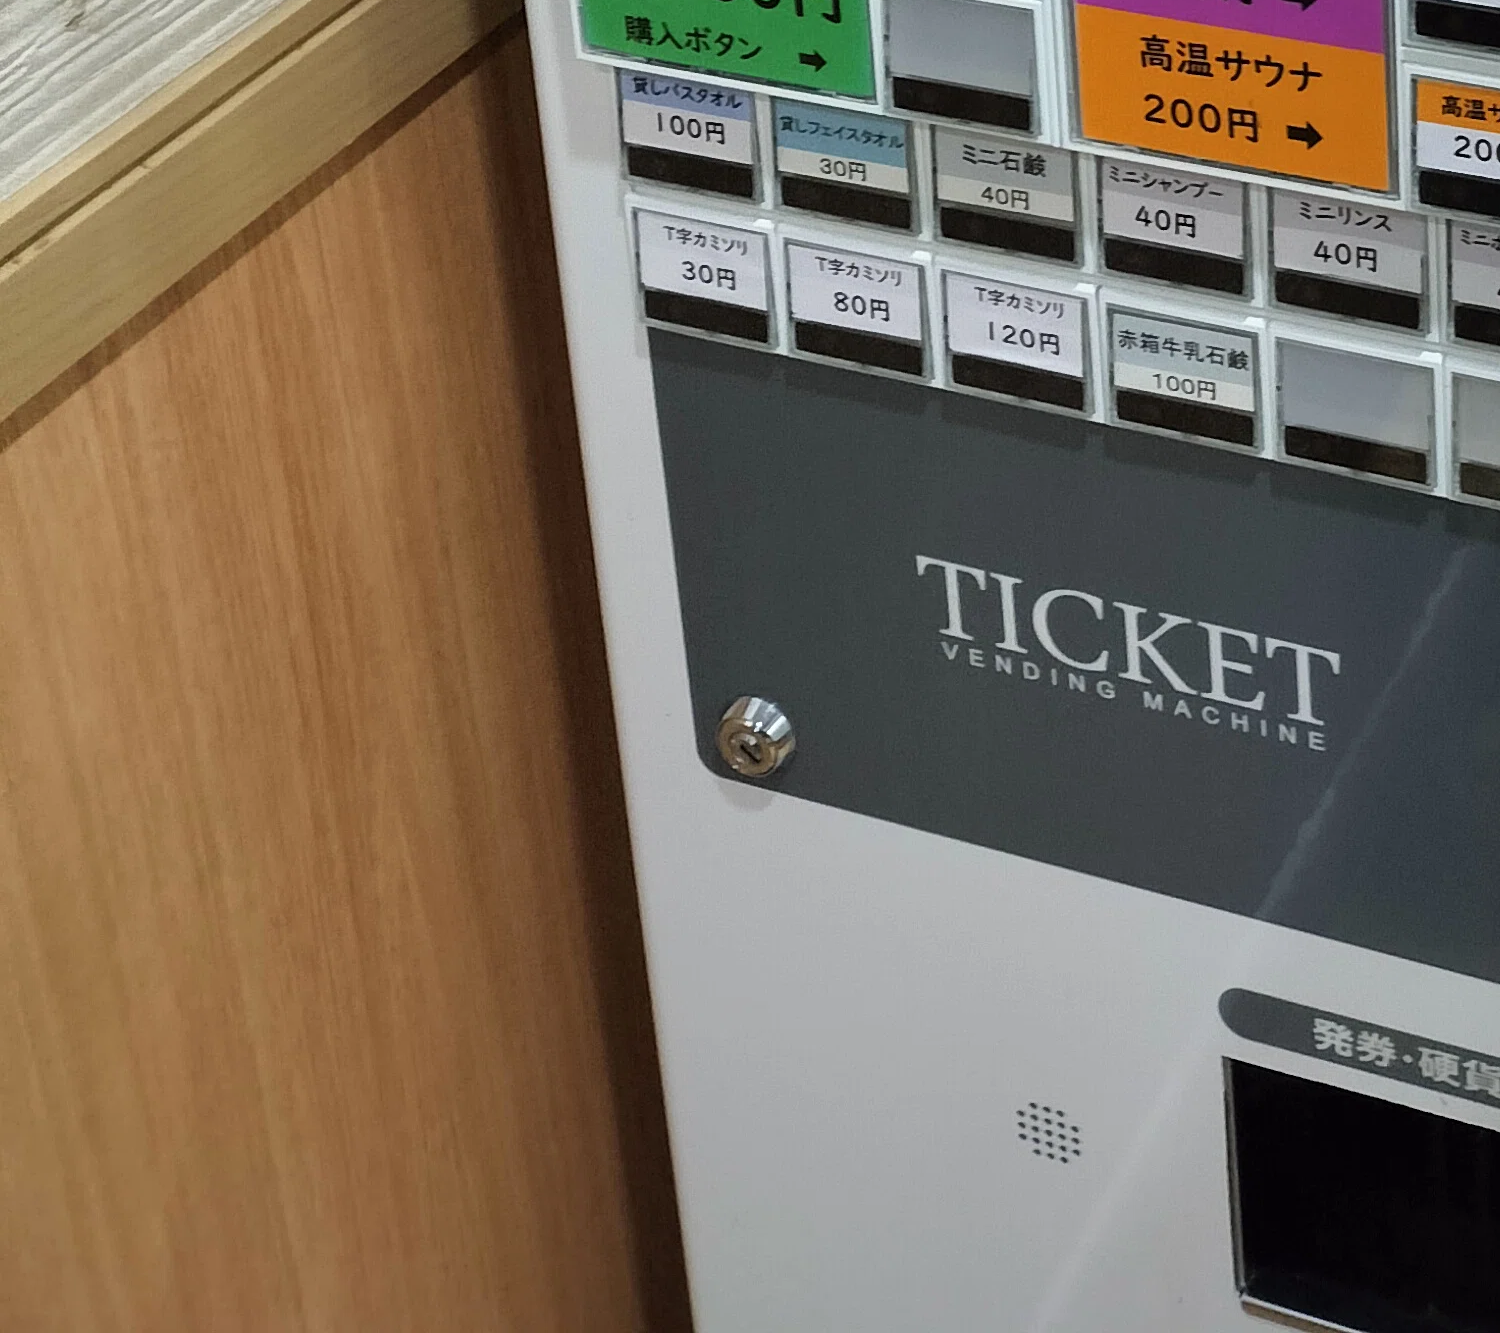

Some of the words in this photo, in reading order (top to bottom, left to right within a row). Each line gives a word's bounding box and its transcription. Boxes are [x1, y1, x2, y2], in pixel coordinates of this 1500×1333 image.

[625, 15, 763, 61] 購入ボタン
[1140, 35, 1323, 92] 高温サウナ
[658, 113, 725, 145] 100円
[1144, 94, 1259, 143] 200円
[820, 158, 866, 181] 30円
[961, 145, 1047, 179] ミニ石鹸
[981, 187, 1029, 212] 40円
[1135, 205, 1196, 240] 40円
[1300, 202, 1393, 232] ミニリンス
[663, 226, 748, 256] T字カミソリ
[1313, 240, 1378, 274] 40円
[682, 260, 736, 292] 30円
[816, 256, 901, 287] T字カミソリ
[834, 293, 890, 323] 80円
[974, 286, 1064, 319] T字カミソリ
[989, 322, 1060, 356] 120円
[1118, 329, 1250, 372] 赤箱牛乳石鹸
[1152, 372, 1216, 401] 100円
[916, 555, 1340, 726] TICKET
[940, 640, 1116, 701] VENDING
[1144, 692, 1327, 752] MACHINE
